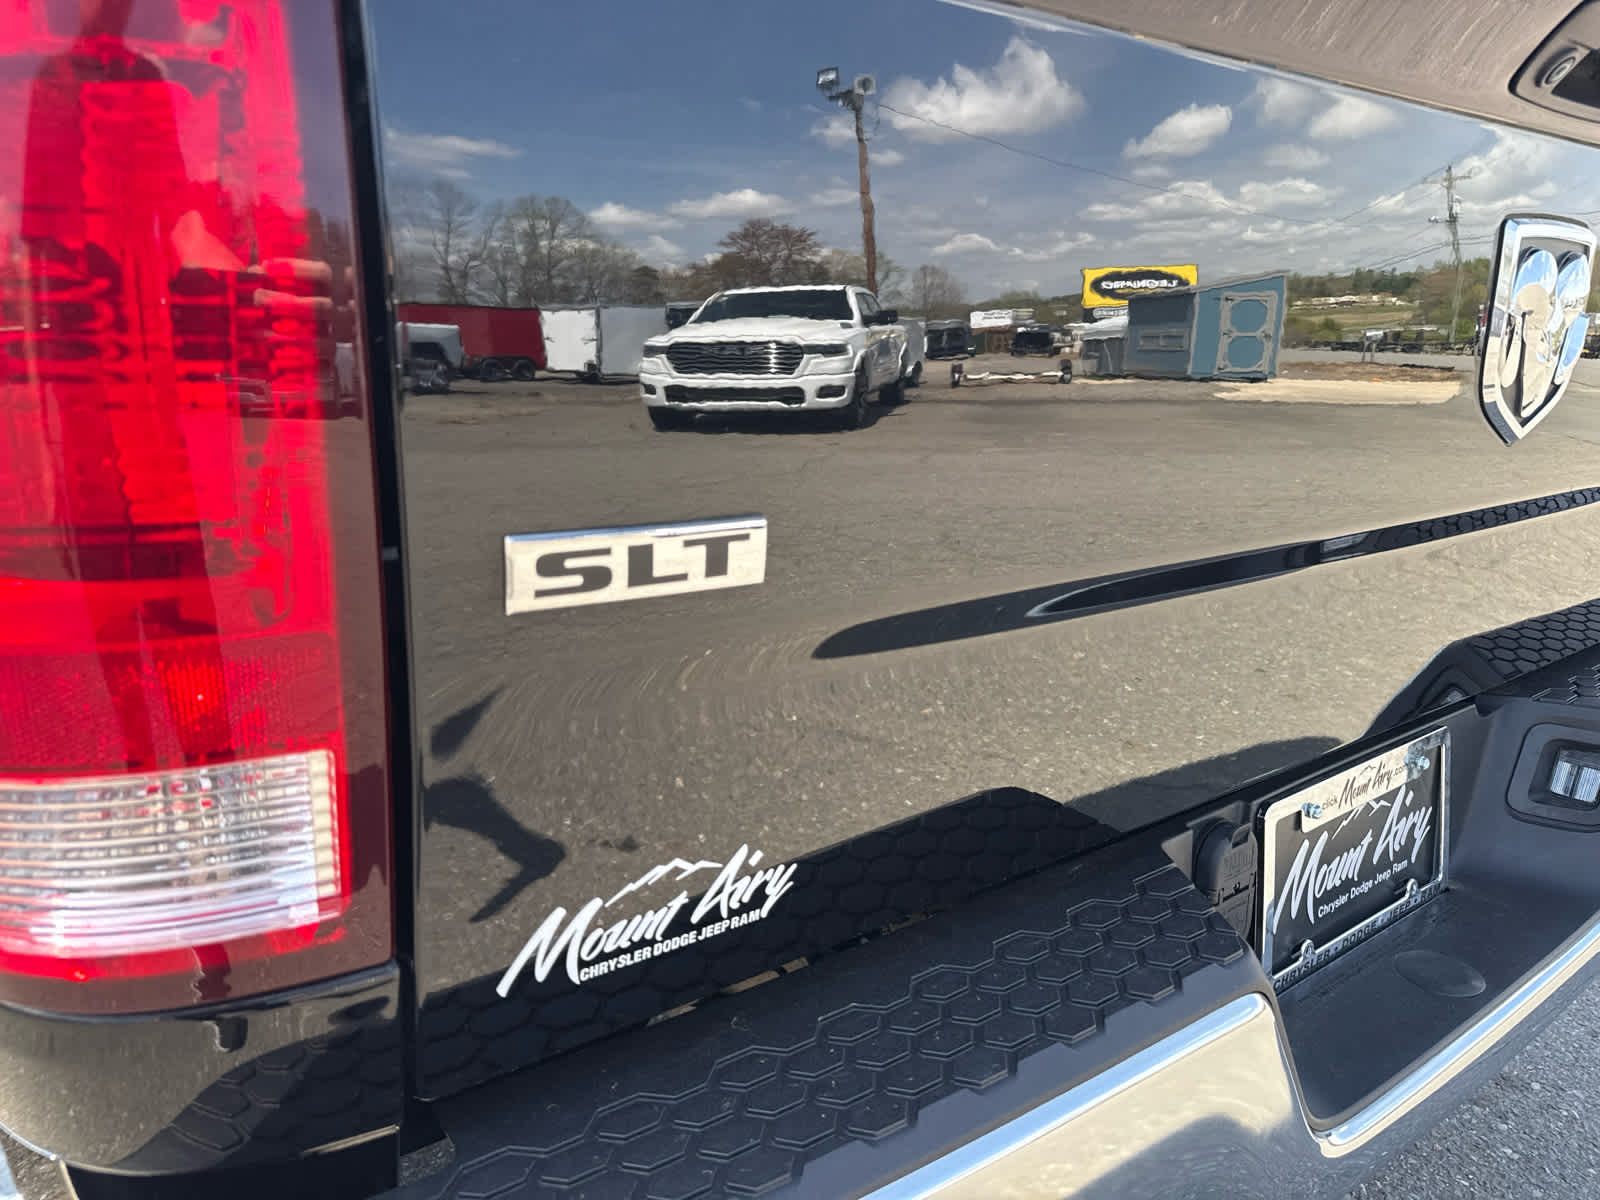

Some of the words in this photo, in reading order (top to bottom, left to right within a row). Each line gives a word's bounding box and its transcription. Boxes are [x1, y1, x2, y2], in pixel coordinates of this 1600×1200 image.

[534, 533, 750, 600] SLT
[1273, 829, 1372, 935] Mount
[1373, 783, 1433, 863] Airy
[1318, 894, 1349, 918] Chrysler
[1350, 880, 1373, 900] Dodge
[1375, 871, 1392, 886] Jeep
[1392, 860, 1408, 875] Ram
[495, 890, 689, 998] Mount
[690, 843, 798, 925] Airy
[579, 947, 652, 982] CHRYSLER
[653, 934, 697, 956] DODGE
[698, 919, 732, 940] JEEP
[731, 908, 761, 928] RAM
[1273, 949, 1330, 990] CHRYSLER
